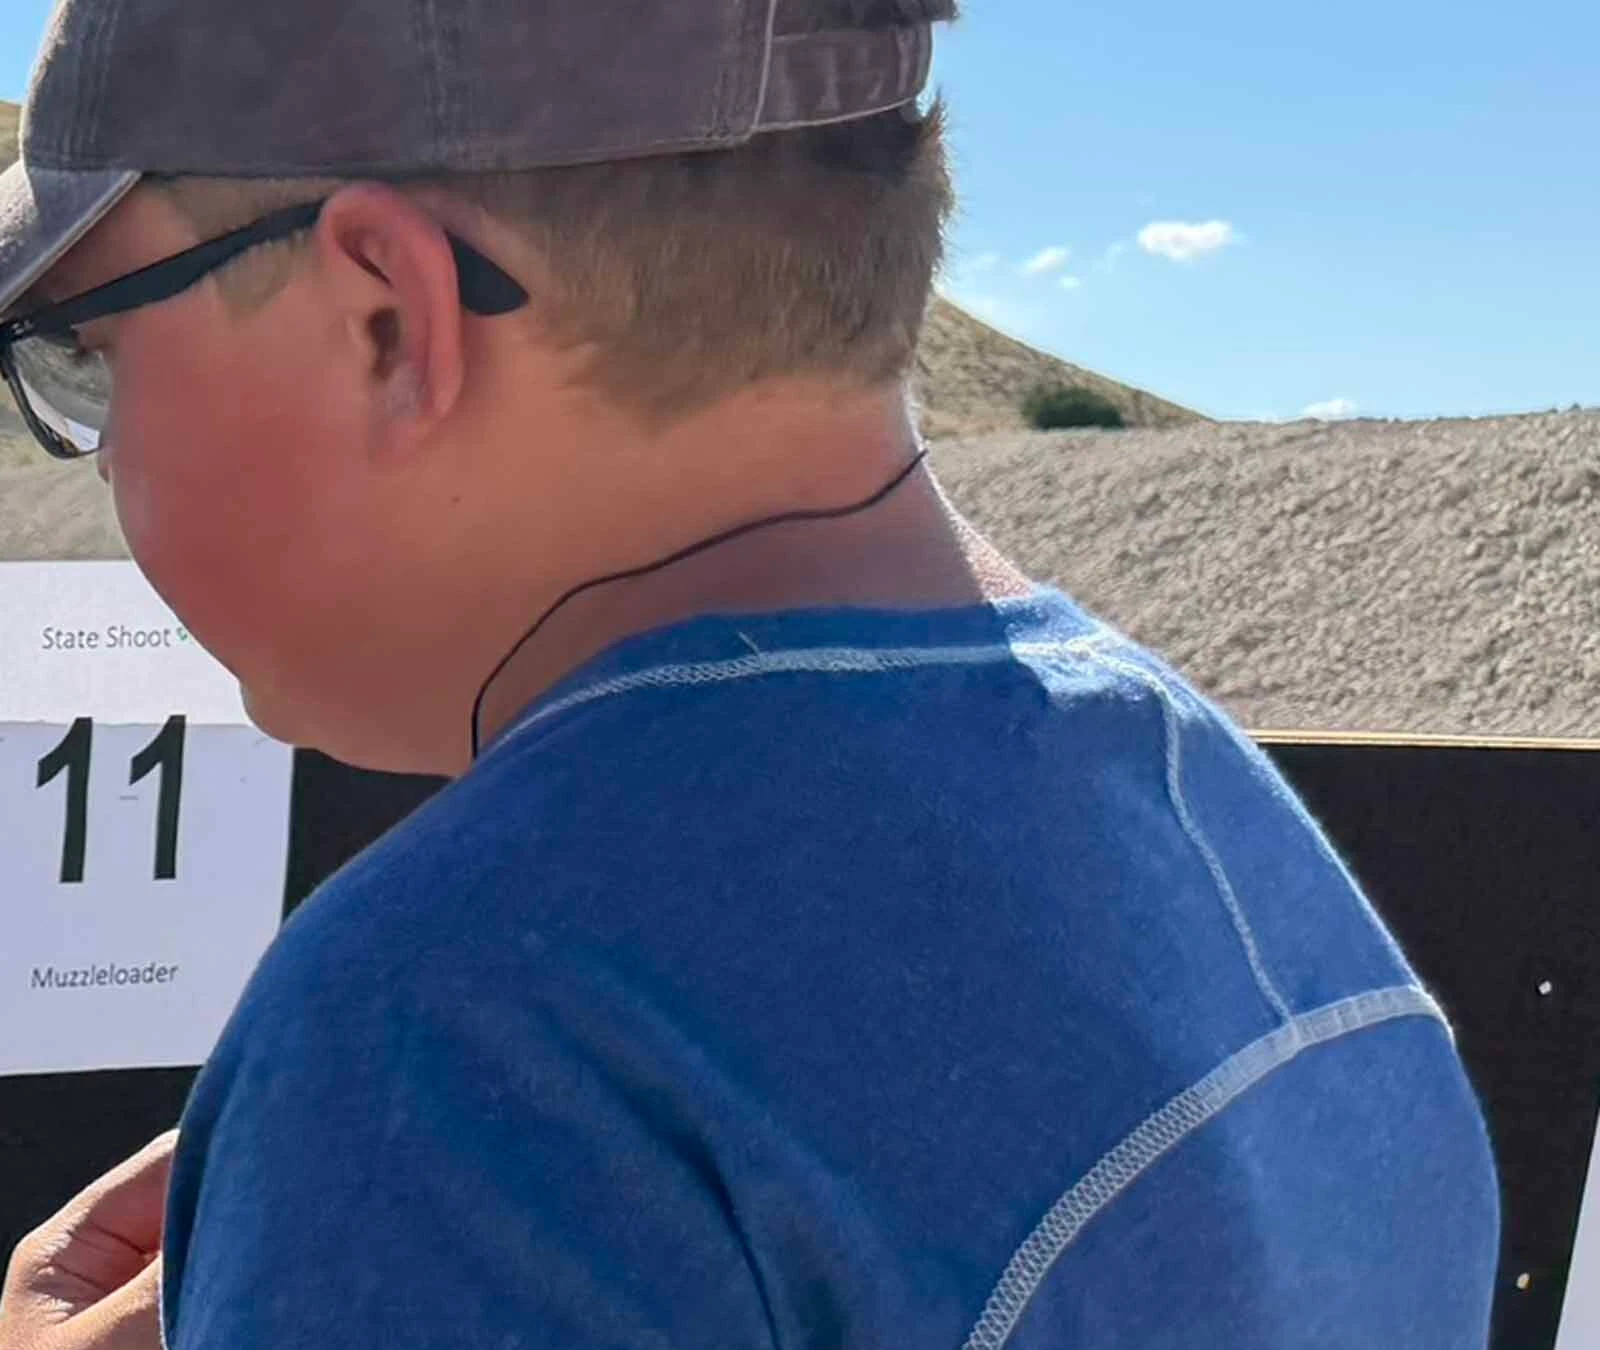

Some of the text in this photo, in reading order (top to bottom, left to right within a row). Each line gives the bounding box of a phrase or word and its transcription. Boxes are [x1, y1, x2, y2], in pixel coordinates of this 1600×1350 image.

[42, 624, 171, 650] State Shoot
[36, 714, 187, 883] 11
[31, 961, 179, 990] Muzzleloader
